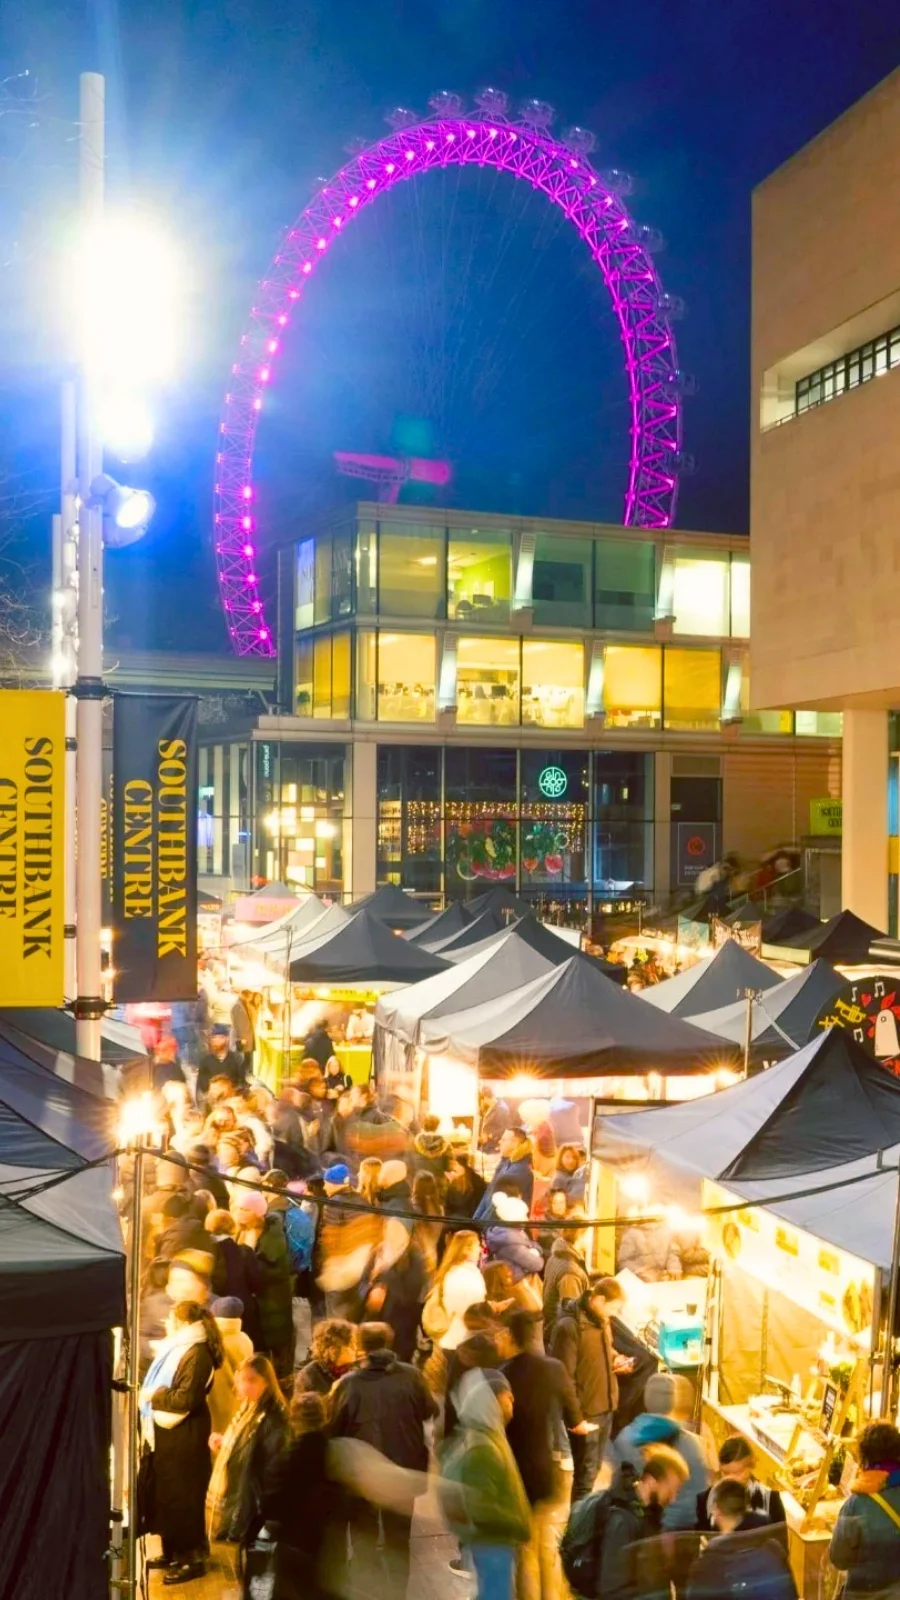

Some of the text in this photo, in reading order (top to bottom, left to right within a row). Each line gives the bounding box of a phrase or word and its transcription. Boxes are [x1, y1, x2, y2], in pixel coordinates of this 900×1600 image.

[23, 737, 53, 960] SOUTHBANK
[124, 780, 153, 918] CENTRE
[158, 739, 187, 958] SOUTHBANK
